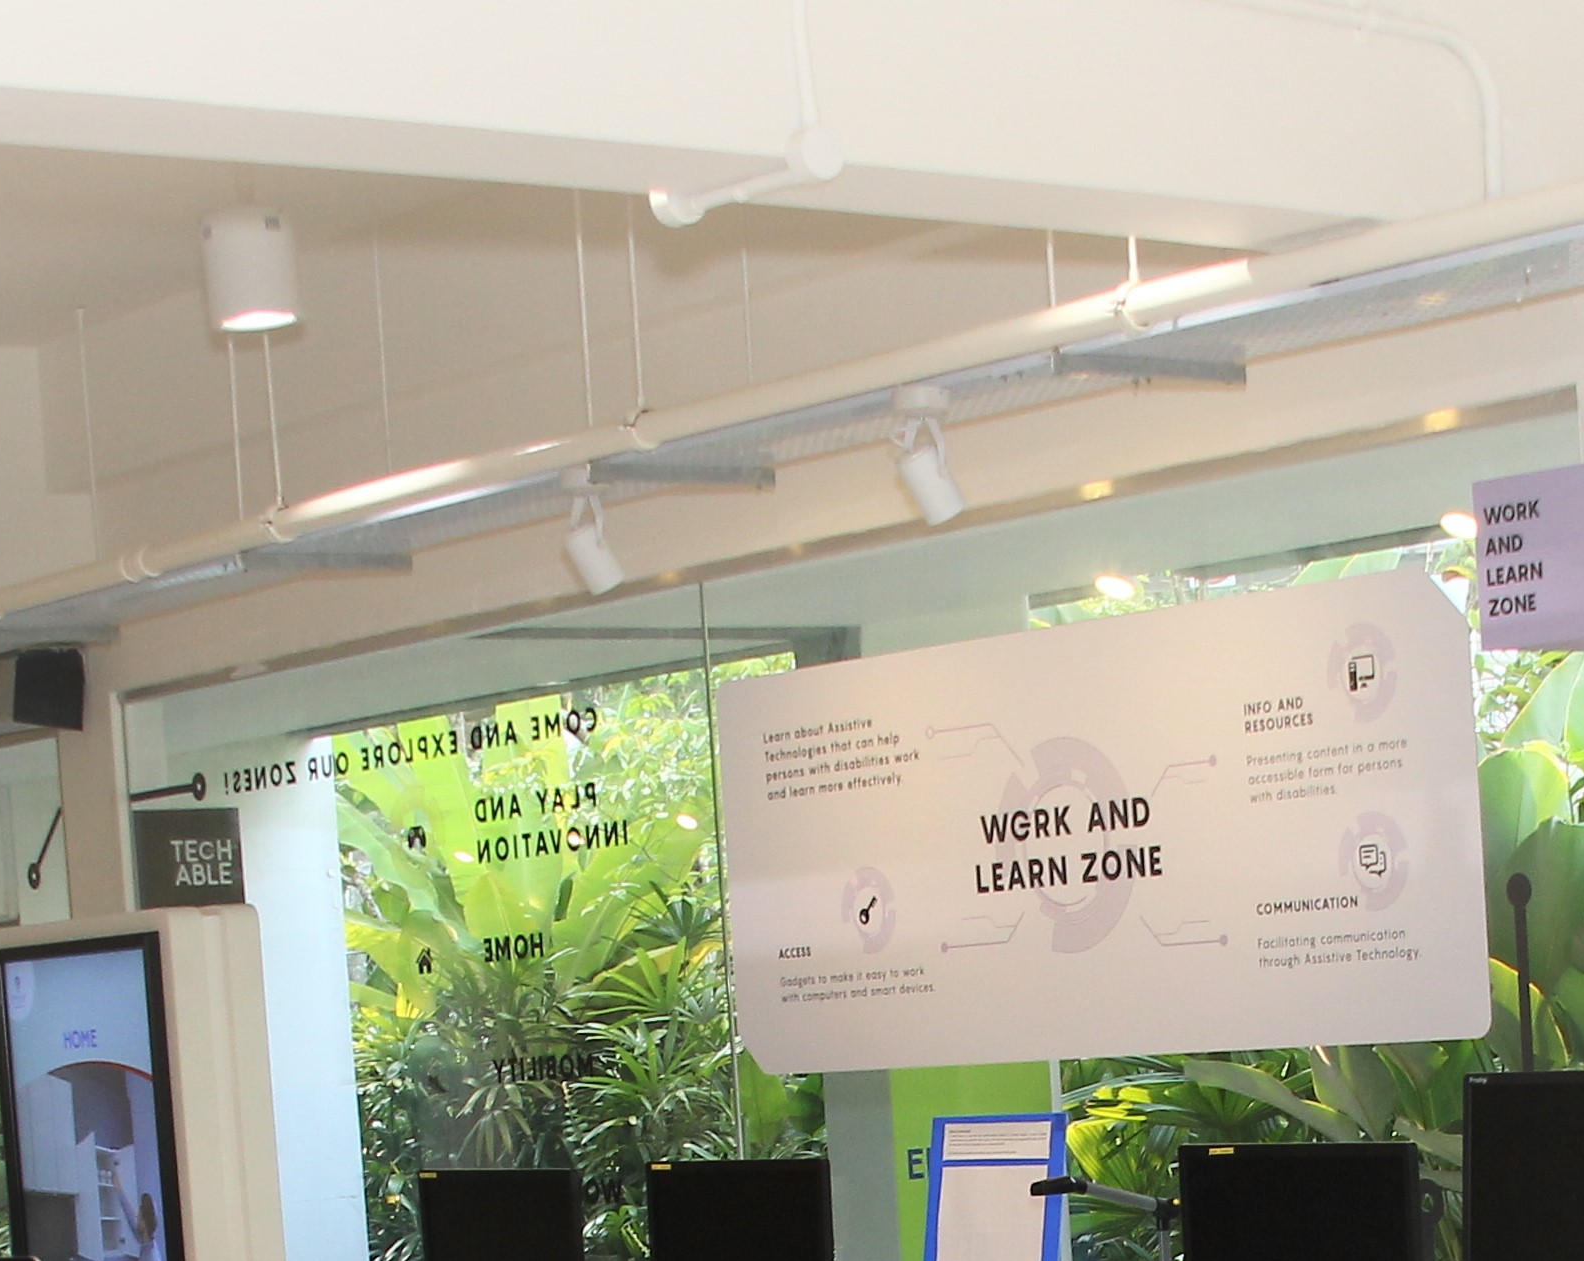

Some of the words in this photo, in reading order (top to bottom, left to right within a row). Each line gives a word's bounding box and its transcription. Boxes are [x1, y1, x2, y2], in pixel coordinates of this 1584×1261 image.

[1484, 501, 1540, 524] WORK
[1486, 535, 1523, 556] AND
[1487, 562, 1543, 587] LEARN
[1489, 594, 1536, 617] ZONE
[1244, 701, 1271, 716] INFO
[1277, 697, 1303, 712] AND
[763, 730, 790, 744] Learn
[795, 725, 823, 739] about
[828, 719, 872, 733] Assistive
[1245, 713, 1313, 733] RESOURCES
[765, 745, 826, 762] Technologies
[831, 741, 851, 753] that
[856, 738, 873, 749] can
[878, 733, 899, 747] help
[1247, 751, 1303, 766] Presenting
[1307, 745, 1349, 759] content
[1353, 742, 1362, 753] in
[1368, 742, 1375, 752] a
[1379, 738, 1407, 749] more
[766, 767, 804, 785] persons
[809, 763, 830, 775] with
[834, 754, 889, 772] disabilities
[895, 749, 919, 763] work
[1248, 768, 1304, 785] accessible
[1309, 766, 1334, 778] form
[1338, 763, 1353, 774] for
[1358, 759, 1402, 775] persons
[768, 788, 786, 800] and
[789, 785, 815, 797] learn
[819, 782, 843, 793] more
[1250, 793, 1272, 803] with
[1088, 797, 1150, 833] AND
[170, 840, 232, 862] TECH
[176, 863, 233, 886] ABLE
[976, 855, 1067, 894] LEARN
[1081, 846, 1162, 883] ZONE
[1256, 896, 1358, 915] COMMUNICATION
[1258, 936, 1315, 949] Facilitating
[1320, 930, 1405, 944] communication
[779, 947, 811, 959] ACCESS
[1259, 953, 1299, 968] through
[1305, 951, 1352, 964] Assistive
[780, 976, 815, 988] Gadgets
[818, 975, 827, 984] to
[830, 972, 853, 982] make
[857, 972, 863, 980] it
[866, 971, 886, 981] easy
[890, 969, 899, 977] to
[903, 965, 924, 976] work
[782, 993, 798, 1003] with
[802, 989, 847, 1002] computers
[851, 988, 867, 997] and
[871, 986, 896, 996] smart
[64, 1029, 97, 1049] HOME
